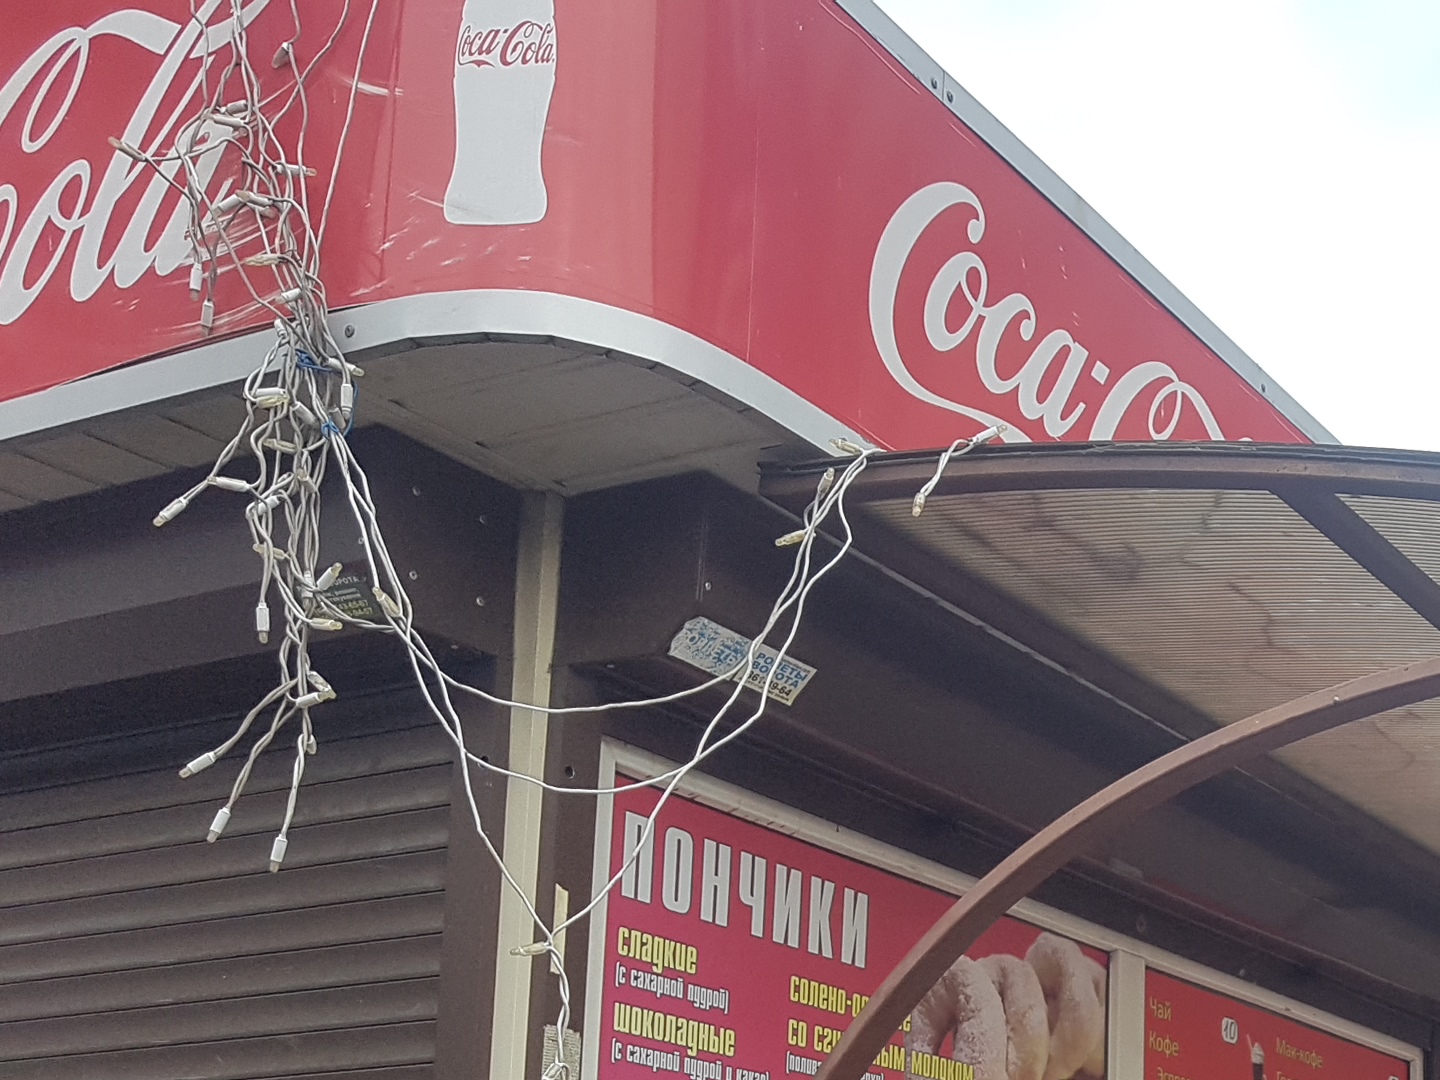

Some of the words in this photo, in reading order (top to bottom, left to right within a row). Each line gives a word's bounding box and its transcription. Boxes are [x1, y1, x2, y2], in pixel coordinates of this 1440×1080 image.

[456, 20, 557, 68] Coca-Cola
[752, 661, 799, 688] ВООТА
[756, 653, 808, 681] РОЕТЫ
[621, 810, 869, 969] ПОНЧИКИ
[617, 926, 698, 974] сладкие
[630, 969, 684, 998] сахарной
[687, 983, 729, 1014] пудрой)
[1149, 996, 1172, 1021] Чай
[613, 1002, 736, 1057] шоколадные
[788, 1018, 807, 1048] со
[1149, 1031, 1179, 1056] Кофе
[1222, 1021, 1238, 1041] 10
[626, 1044, 680, 1072] сахарной
[1276, 1037, 1323, 1069] Мак-кофе
